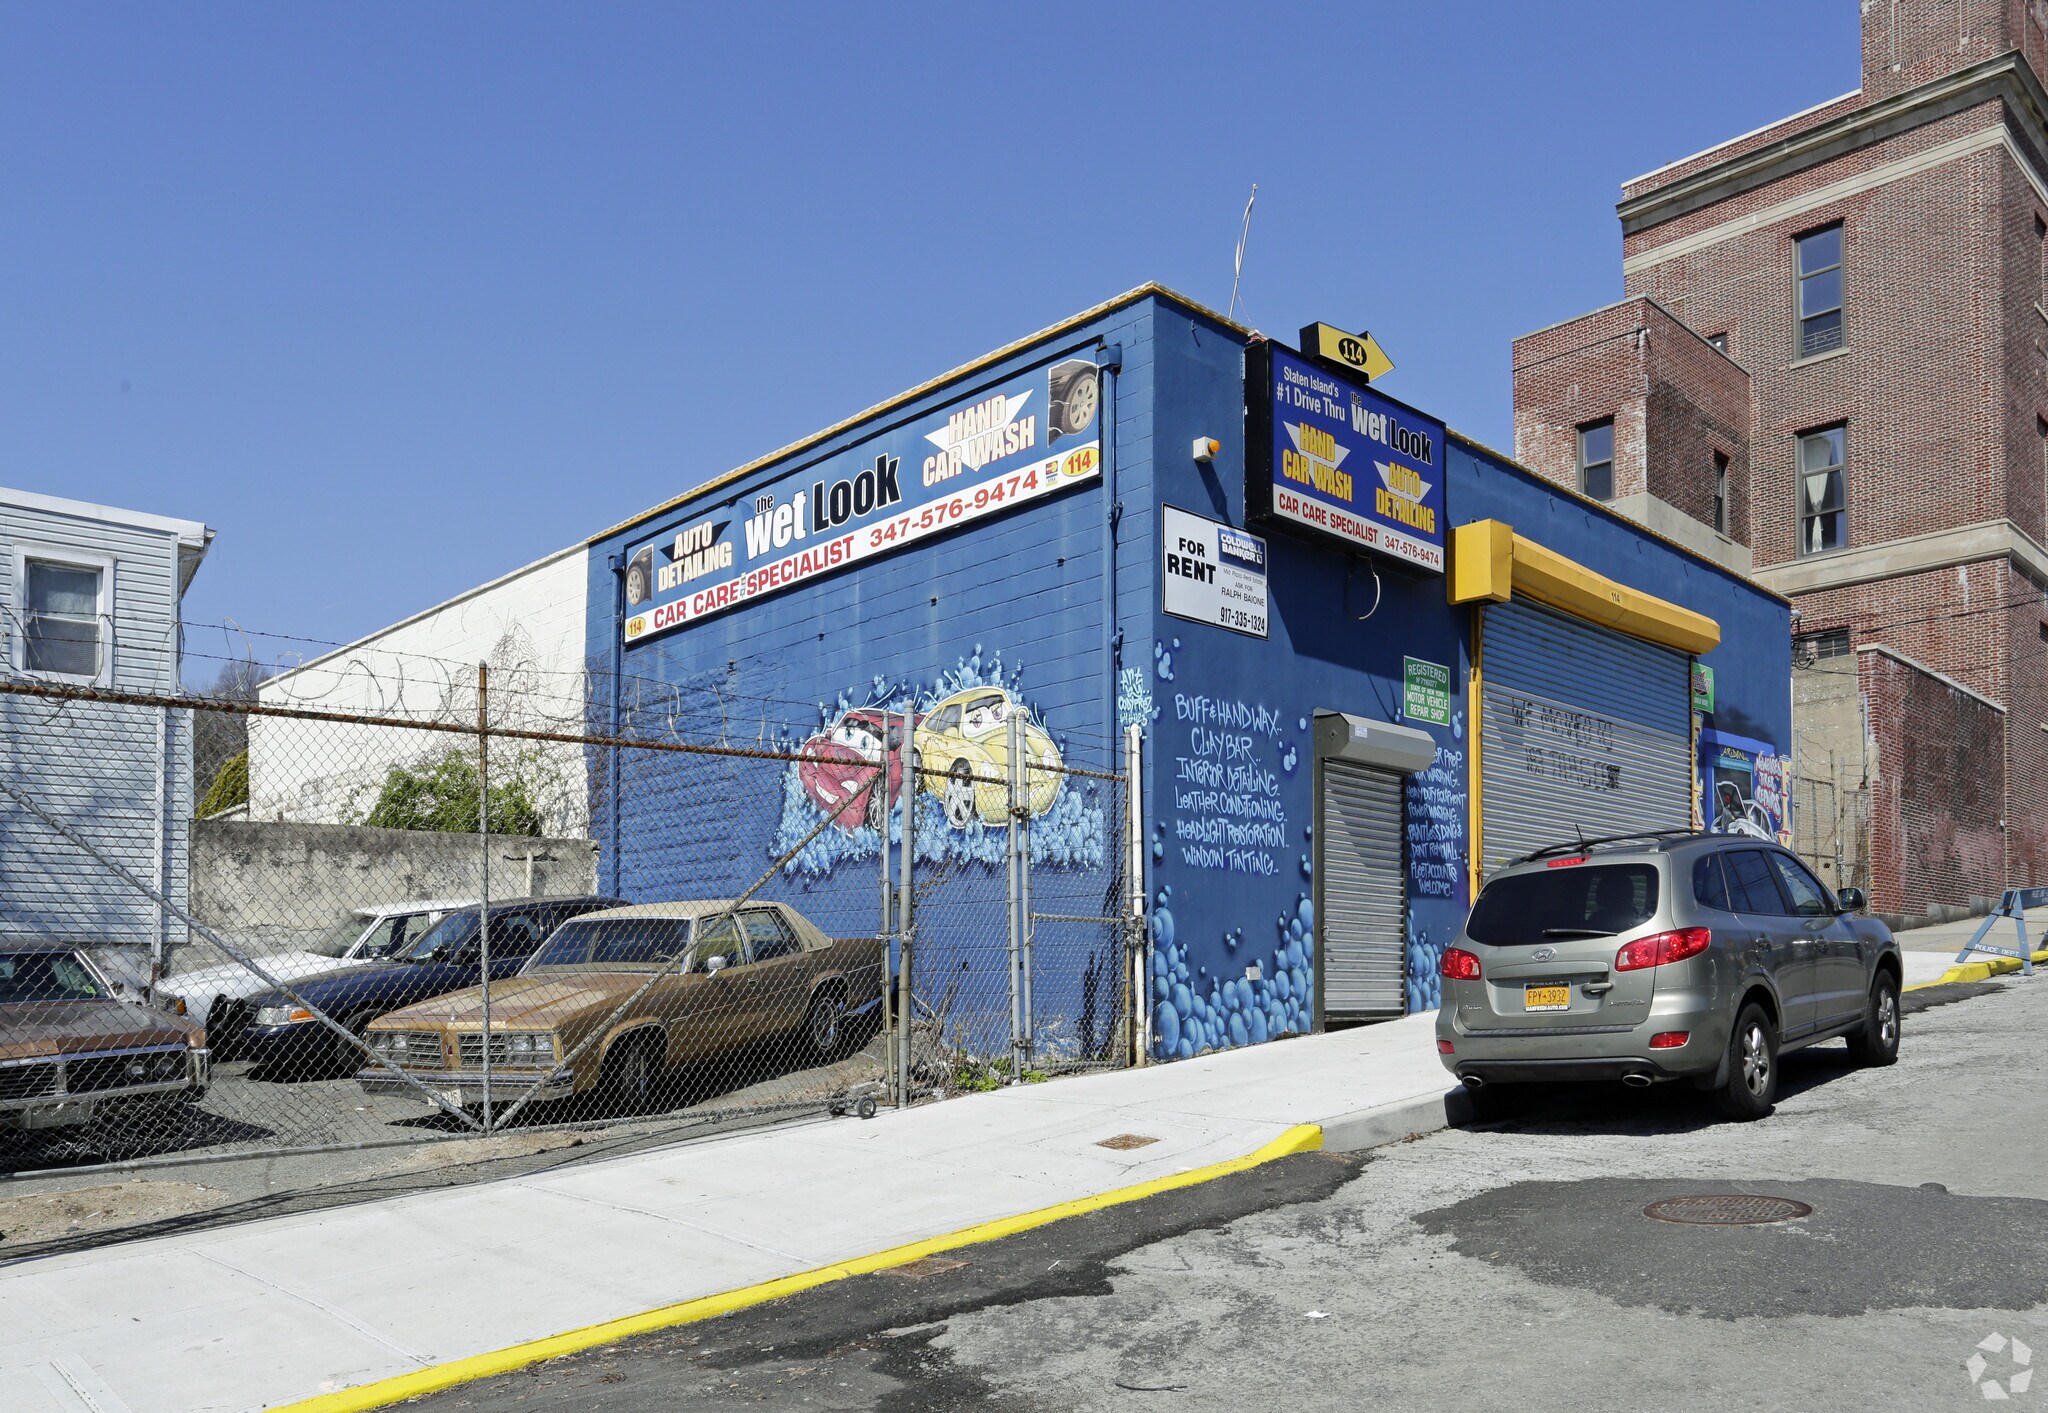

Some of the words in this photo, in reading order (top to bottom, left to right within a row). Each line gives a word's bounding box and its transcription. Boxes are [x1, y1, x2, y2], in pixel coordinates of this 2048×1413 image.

[1342, 340, 1363, 363] 114
[1284, 366, 1309, 388] Staten
[1310, 375, 1339, 398] Island's
[1277, 382, 1290, 404] #1
[1294, 387, 1321, 414] Drive
[1323, 396, 1345, 421] Thru
[1350, 391, 1362, 406] the
[949, 394, 1006, 445] HAND
[923, 444, 962, 487] CAR
[968, 415, 1036, 470] WASH
[1299, 422, 1336, 463] HAND
[1389, 417, 1432, 466] Look
[1068, 450, 1091, 474] 114
[1282, 449, 1310, 485] CAR
[1313, 461, 1353, 502] WASH
[812, 452, 902, 535] Look
[1389, 461, 1421, 498] AUTO
[756, 494, 773, 514] the
[1375, 487, 1436, 535] DETAILING
[674, 521, 712, 560] AUTO
[1221, 533, 1263, 555] COLDWELL
[1279, 493, 1299, 516] CAR
[1302, 502, 1327, 526] CARE
[1330, 513, 1379, 545] SPECIALIST
[1384, 535, 1439, 566] 347-576-9474
[654, 601, 686, 629] CAR
[693, 581, 739, 615] CARE
[746, 535, 854, 596] SPECIALIST
[870, 470, 1038, 548] 347-576-9474
[1179, 537, 1206, 558] FOR
[1222, 542, 1256, 562] BANKER
[658, 541, 732, 592] DETAILING
[1167, 553, 1216, 585] RENT
[1221, 587, 1242, 600] RALPH
[1243, 593, 1265, 607] BAIONE
[1245, 584, 1253, 592] FOR
[629, 620, 642, 635] 114
[1220, 607, 1265, 633] 917-335-1324
[1408, 664, 1447, 684] REGISTERED
[1407, 691, 1425, 705] MOTOR
[1427, 695, 1448, 710] VEHICLE
[1410, 684, 1421, 692] STATE
[1427, 688, 1435, 696] NEW
[1435, 690, 1445, 698] YORK
[1175, 693, 1210, 724] BUFF
[1217, 699, 1252, 730] HAND
[1410, 704, 1429, 717] REPAIR
[1431, 708, 1445, 720] SHOP
[1191, 726, 1224, 763] CLAY
[1975, 943, 1998, 953] POLICE
